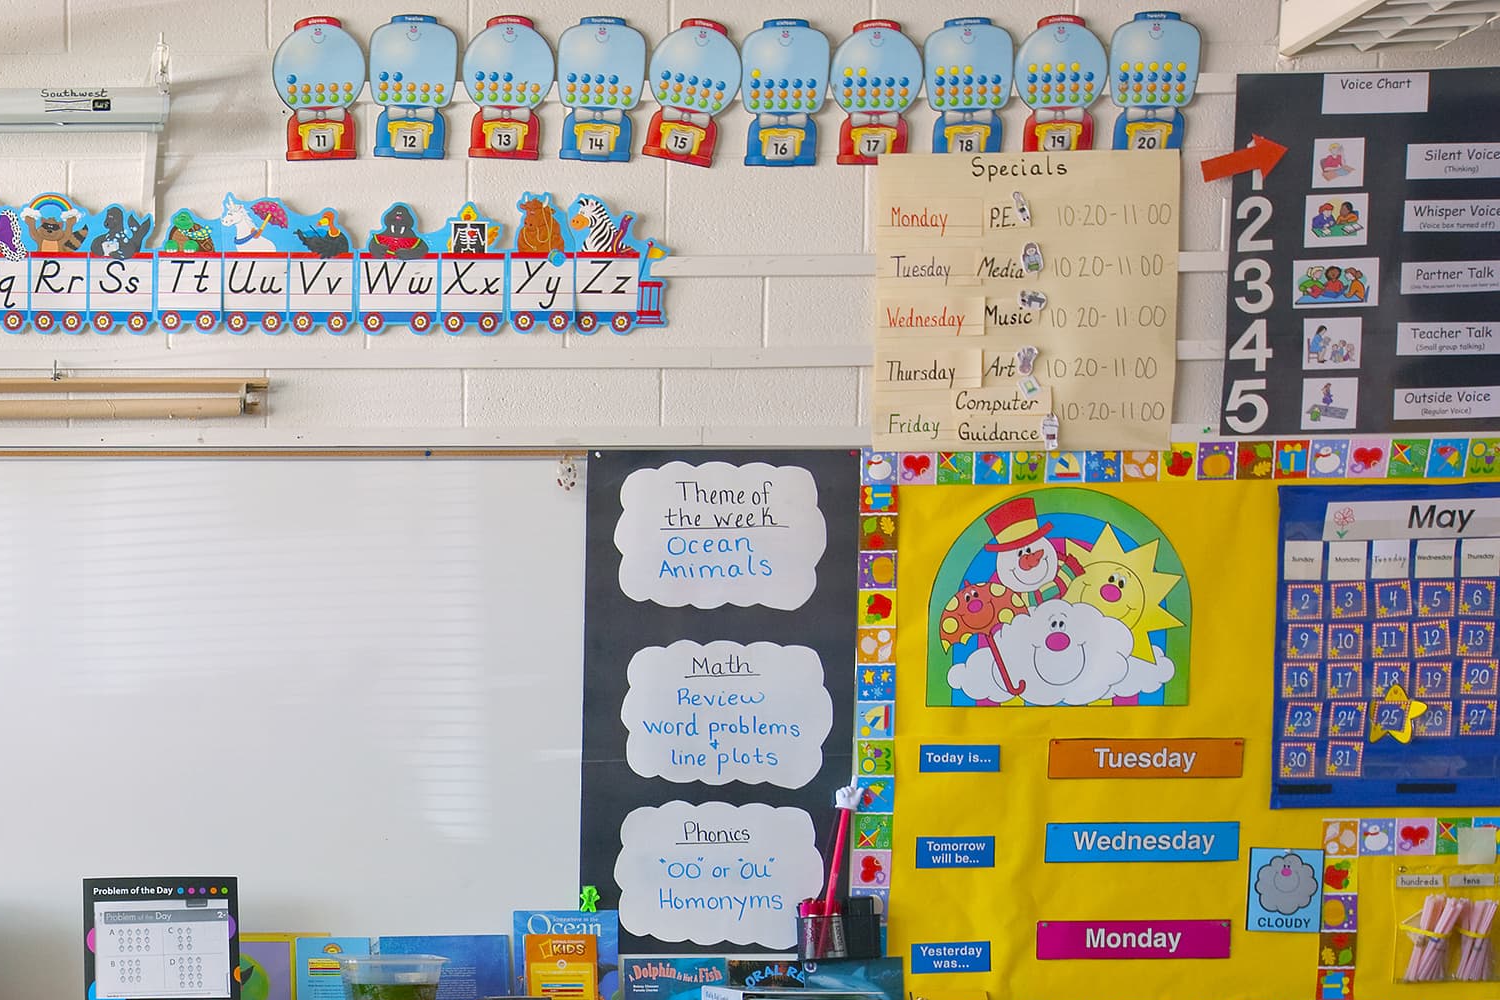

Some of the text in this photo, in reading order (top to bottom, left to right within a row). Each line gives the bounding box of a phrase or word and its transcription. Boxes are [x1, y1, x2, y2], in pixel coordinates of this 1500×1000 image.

[41, 88, 108, 98] Southwest
[1340, 78, 1412, 90] Voice Chart
[315, 134, 328, 148] 11
[497, 134, 512, 146] 13
[673, 136, 688, 150] 15
[1137, 136, 1157, 149] 20
[1424, 149, 1462, 161] Silent
[971, 155, 1068, 182] Specials
[891, 206, 949, 237] Monday
[1413, 205, 1467, 219] Whisper
[1236, 196, 1274, 252] 2
[890, 255, 1025, 285] Tuesday Media
[1415, 266, 1495, 281] Partner Talk
[34, 260, 85, 294] Rr
[98, 260, 140, 294] Ss
[170, 260, 210, 294] Tt
[227, 259, 283, 295] Uu
[299, 260, 342, 295] Vv
[364, 260, 436, 295] Ww
[442, 260, 501, 295] Xx
[514, 260, 563, 309] Yy
[578, 260, 632, 295] Zz
[1233, 258, 1274, 314] 3
[886, 304, 1033, 337] Wednesday Music
[1411, 327, 1493, 339] Teacher Talk
[1228, 318, 1273, 372] 4
[886, 356, 1016, 389] Thursday Art
[956, 390, 1039, 416] Computer
[1224, 378, 1269, 434] 5
[1404, 390, 1491, 404] Outside Voice
[888, 413, 940, 438] Friday
[957, 422, 1040, 442] Guidance
[675, 480, 773, 506] Theme of
[664, 508, 778, 528] the week
[1408, 503, 1476, 534] May
[666, 534, 755, 557] Ocean
[657, 555, 773, 580] Animals
[691, 654, 754, 676] Math
[1470, 669, 1489, 685] 20
[677, 686, 766, 707] Review
[1294, 711, 1312, 727] 23
[1381, 710, 1399, 726] 25
[642, 715, 801, 748] word problems
[669, 747, 779, 776] line plots
[926, 752, 992, 766] Today is...
[1093, 747, 1197, 773] Tuesday
[1335, 750, 1351, 766] 31
[683, 820, 751, 845] Phonics
[1073, 830, 1216, 855] Wednesday
[926, 841, 986, 853] Tomorrow
[931, 853, 980, 864] will be...
[711, 862, 731, 880] or
[93, 886, 173, 897] Problem of the Day
[657, 888, 783, 921] Homonyms
[1257, 917, 1311, 929] CLOUDY
[552, 943, 586, 955] KIDS
[1084, 928, 1182, 952] Monday
[920, 945, 983, 959] Yesterday
[633, 962, 723, 983] Dolphin Fish
[933, 958, 970, 969] was...
